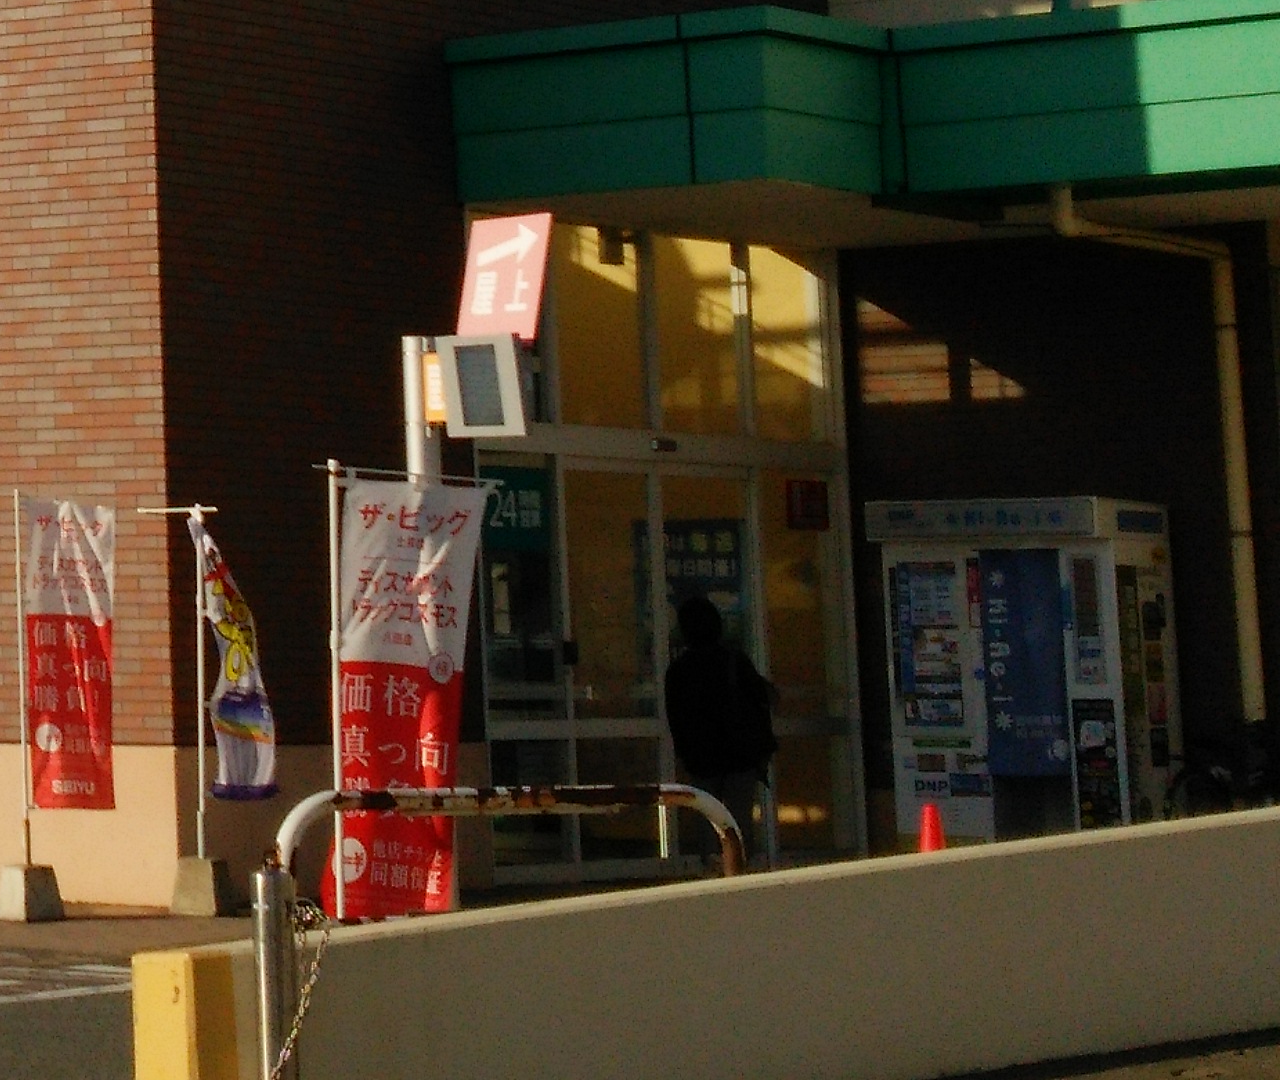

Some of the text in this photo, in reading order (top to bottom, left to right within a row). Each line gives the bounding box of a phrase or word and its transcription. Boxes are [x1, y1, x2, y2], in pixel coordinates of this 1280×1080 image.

[358, 502, 472, 536] ザ・ビッグ
[34, 619, 88, 650] 価格
[340, 672, 422, 717] 価格
[341, 724, 450, 776] 真っ向
